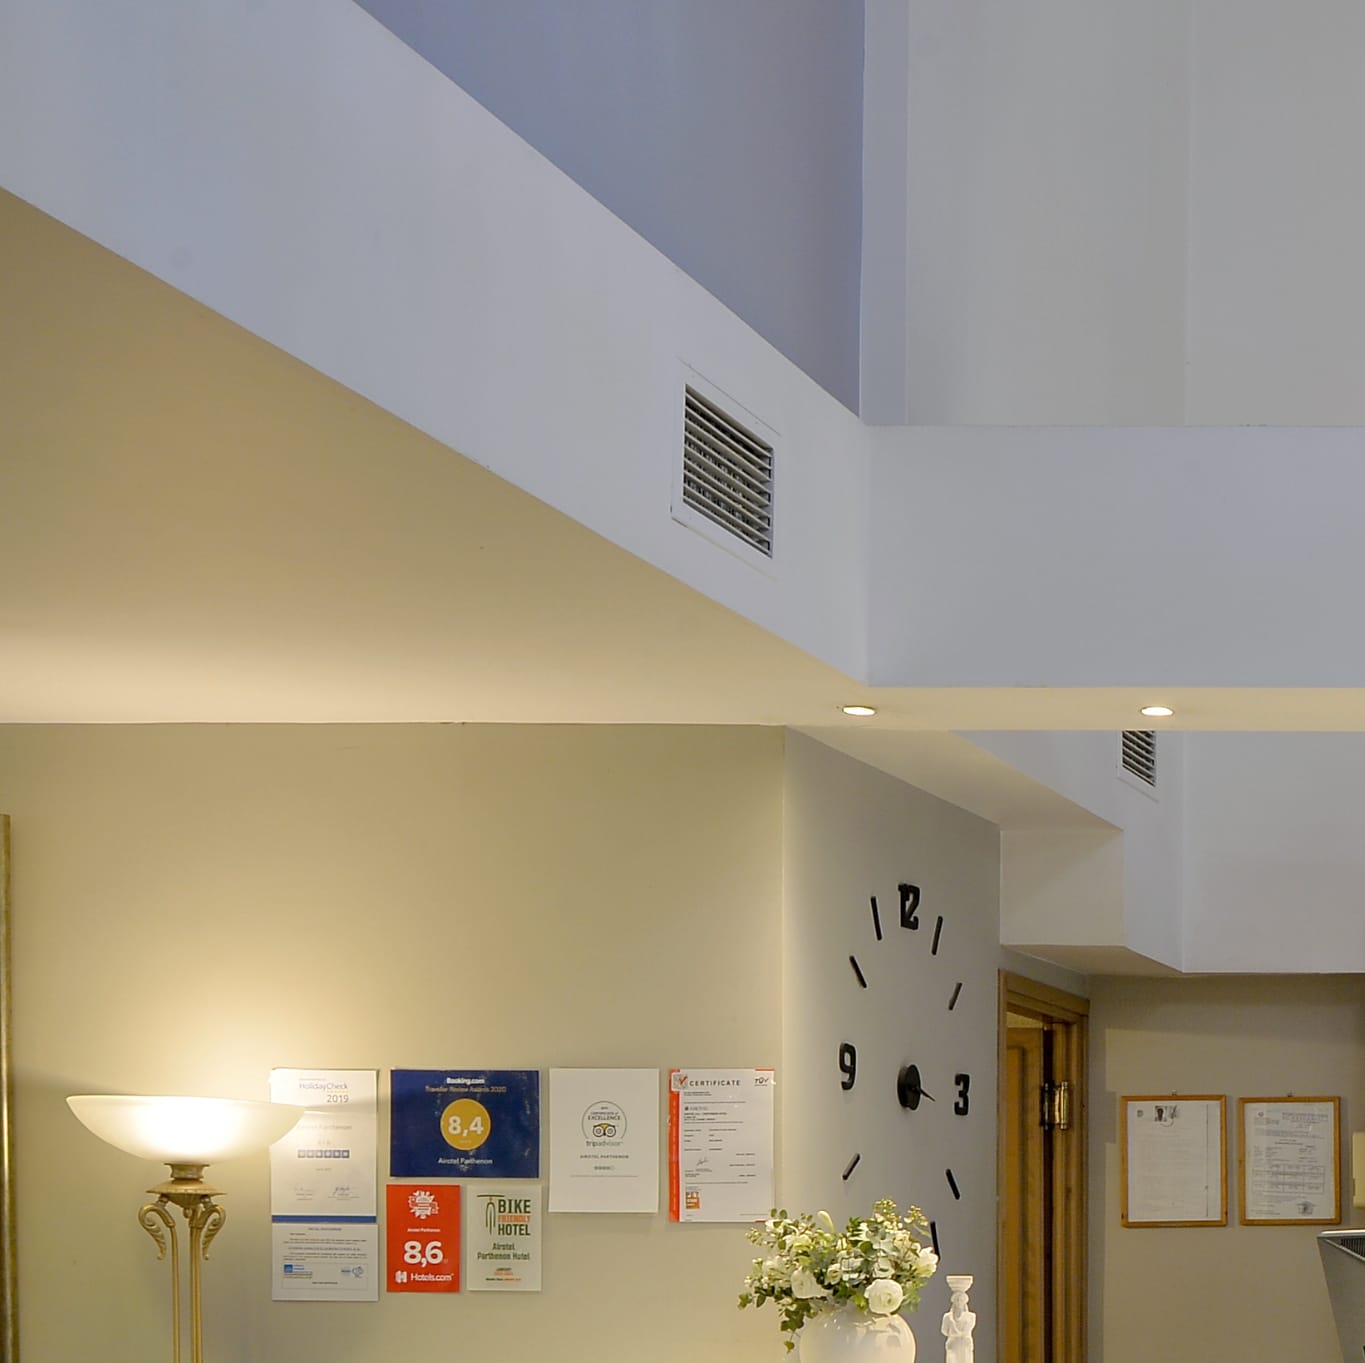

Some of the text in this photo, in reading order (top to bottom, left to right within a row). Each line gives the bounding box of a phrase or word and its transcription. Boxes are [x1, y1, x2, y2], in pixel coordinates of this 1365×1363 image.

[897, 883, 920, 930] 12
[838, 1042, 856, 1090] 9
[299, 1082, 348, 1091] HolidayCheck
[446, 1077, 485, 1085] Booking.com
[689, 1079, 741, 1087] CERTIFICATE
[326, 1094, 349, 1103] 2019
[954, 1074, 970, 1116] 3
[448, 1116, 484, 1137] 8,4
[498, 1199, 531, 1213] BIKE
[498, 1224, 531, 1235] HOTEL
[403, 1240, 443, 1267] 8,6
[512, 1252, 530, 1260] Hotel
[411, 1272, 451, 1281] Hotels.com
